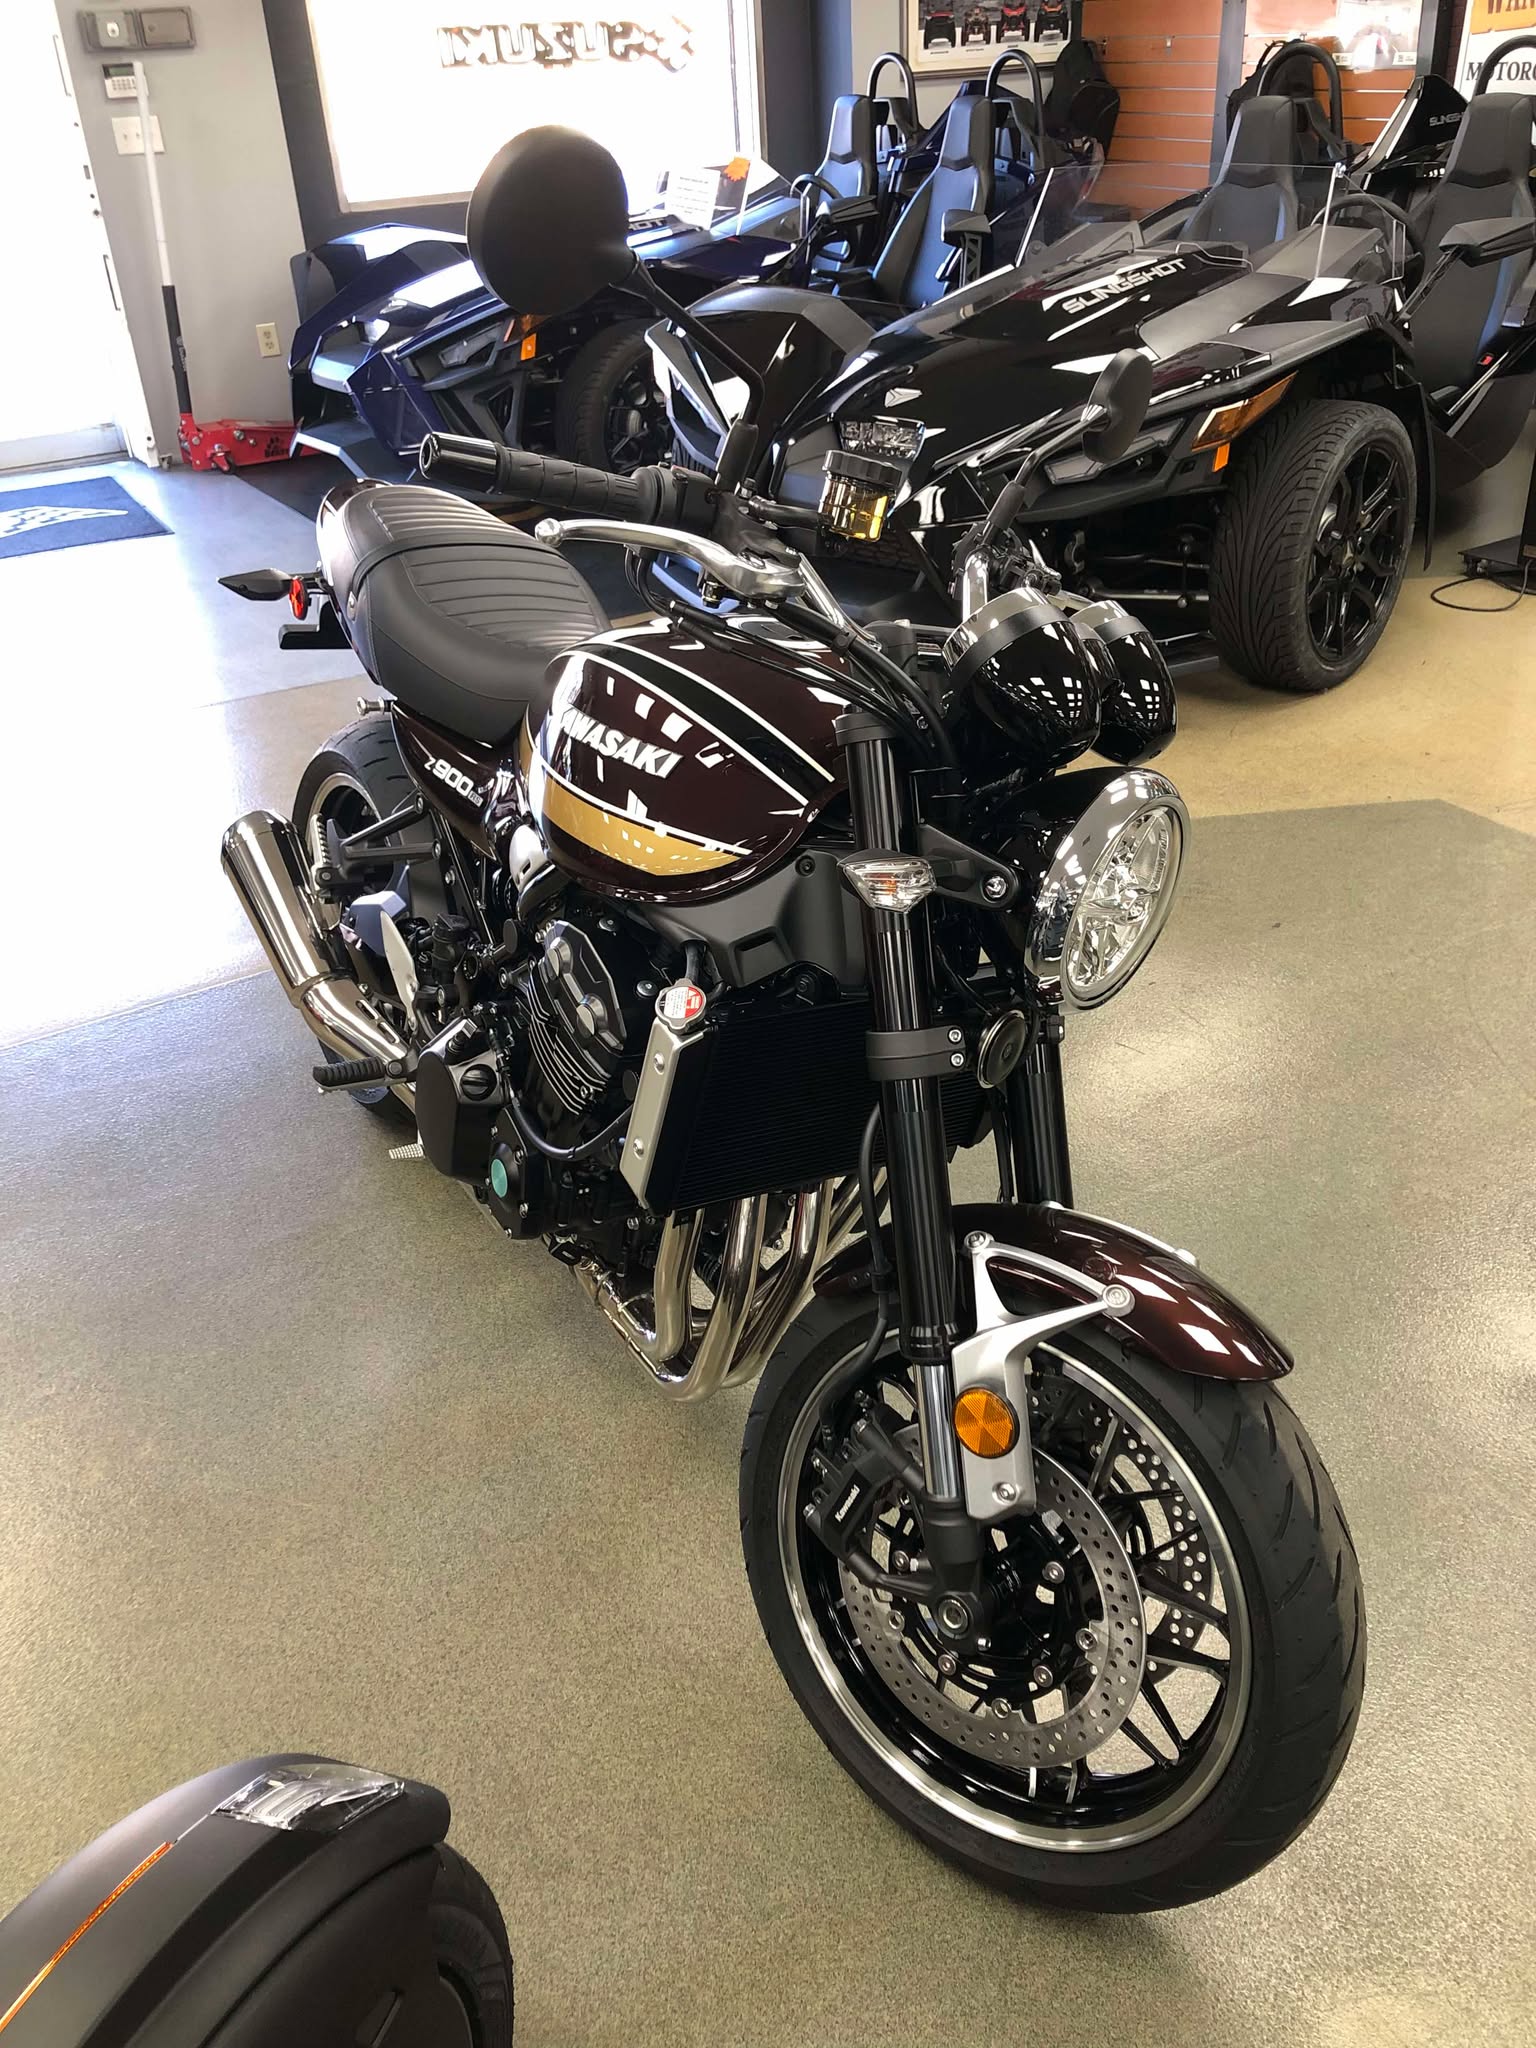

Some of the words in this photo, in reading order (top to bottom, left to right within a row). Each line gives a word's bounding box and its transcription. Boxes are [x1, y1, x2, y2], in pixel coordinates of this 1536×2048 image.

[1465, 61, 1536, 81] MTOR
[1061, 258, 1187, 314] SLINGSHOT
[549, 703, 684, 779] AWASAKI
